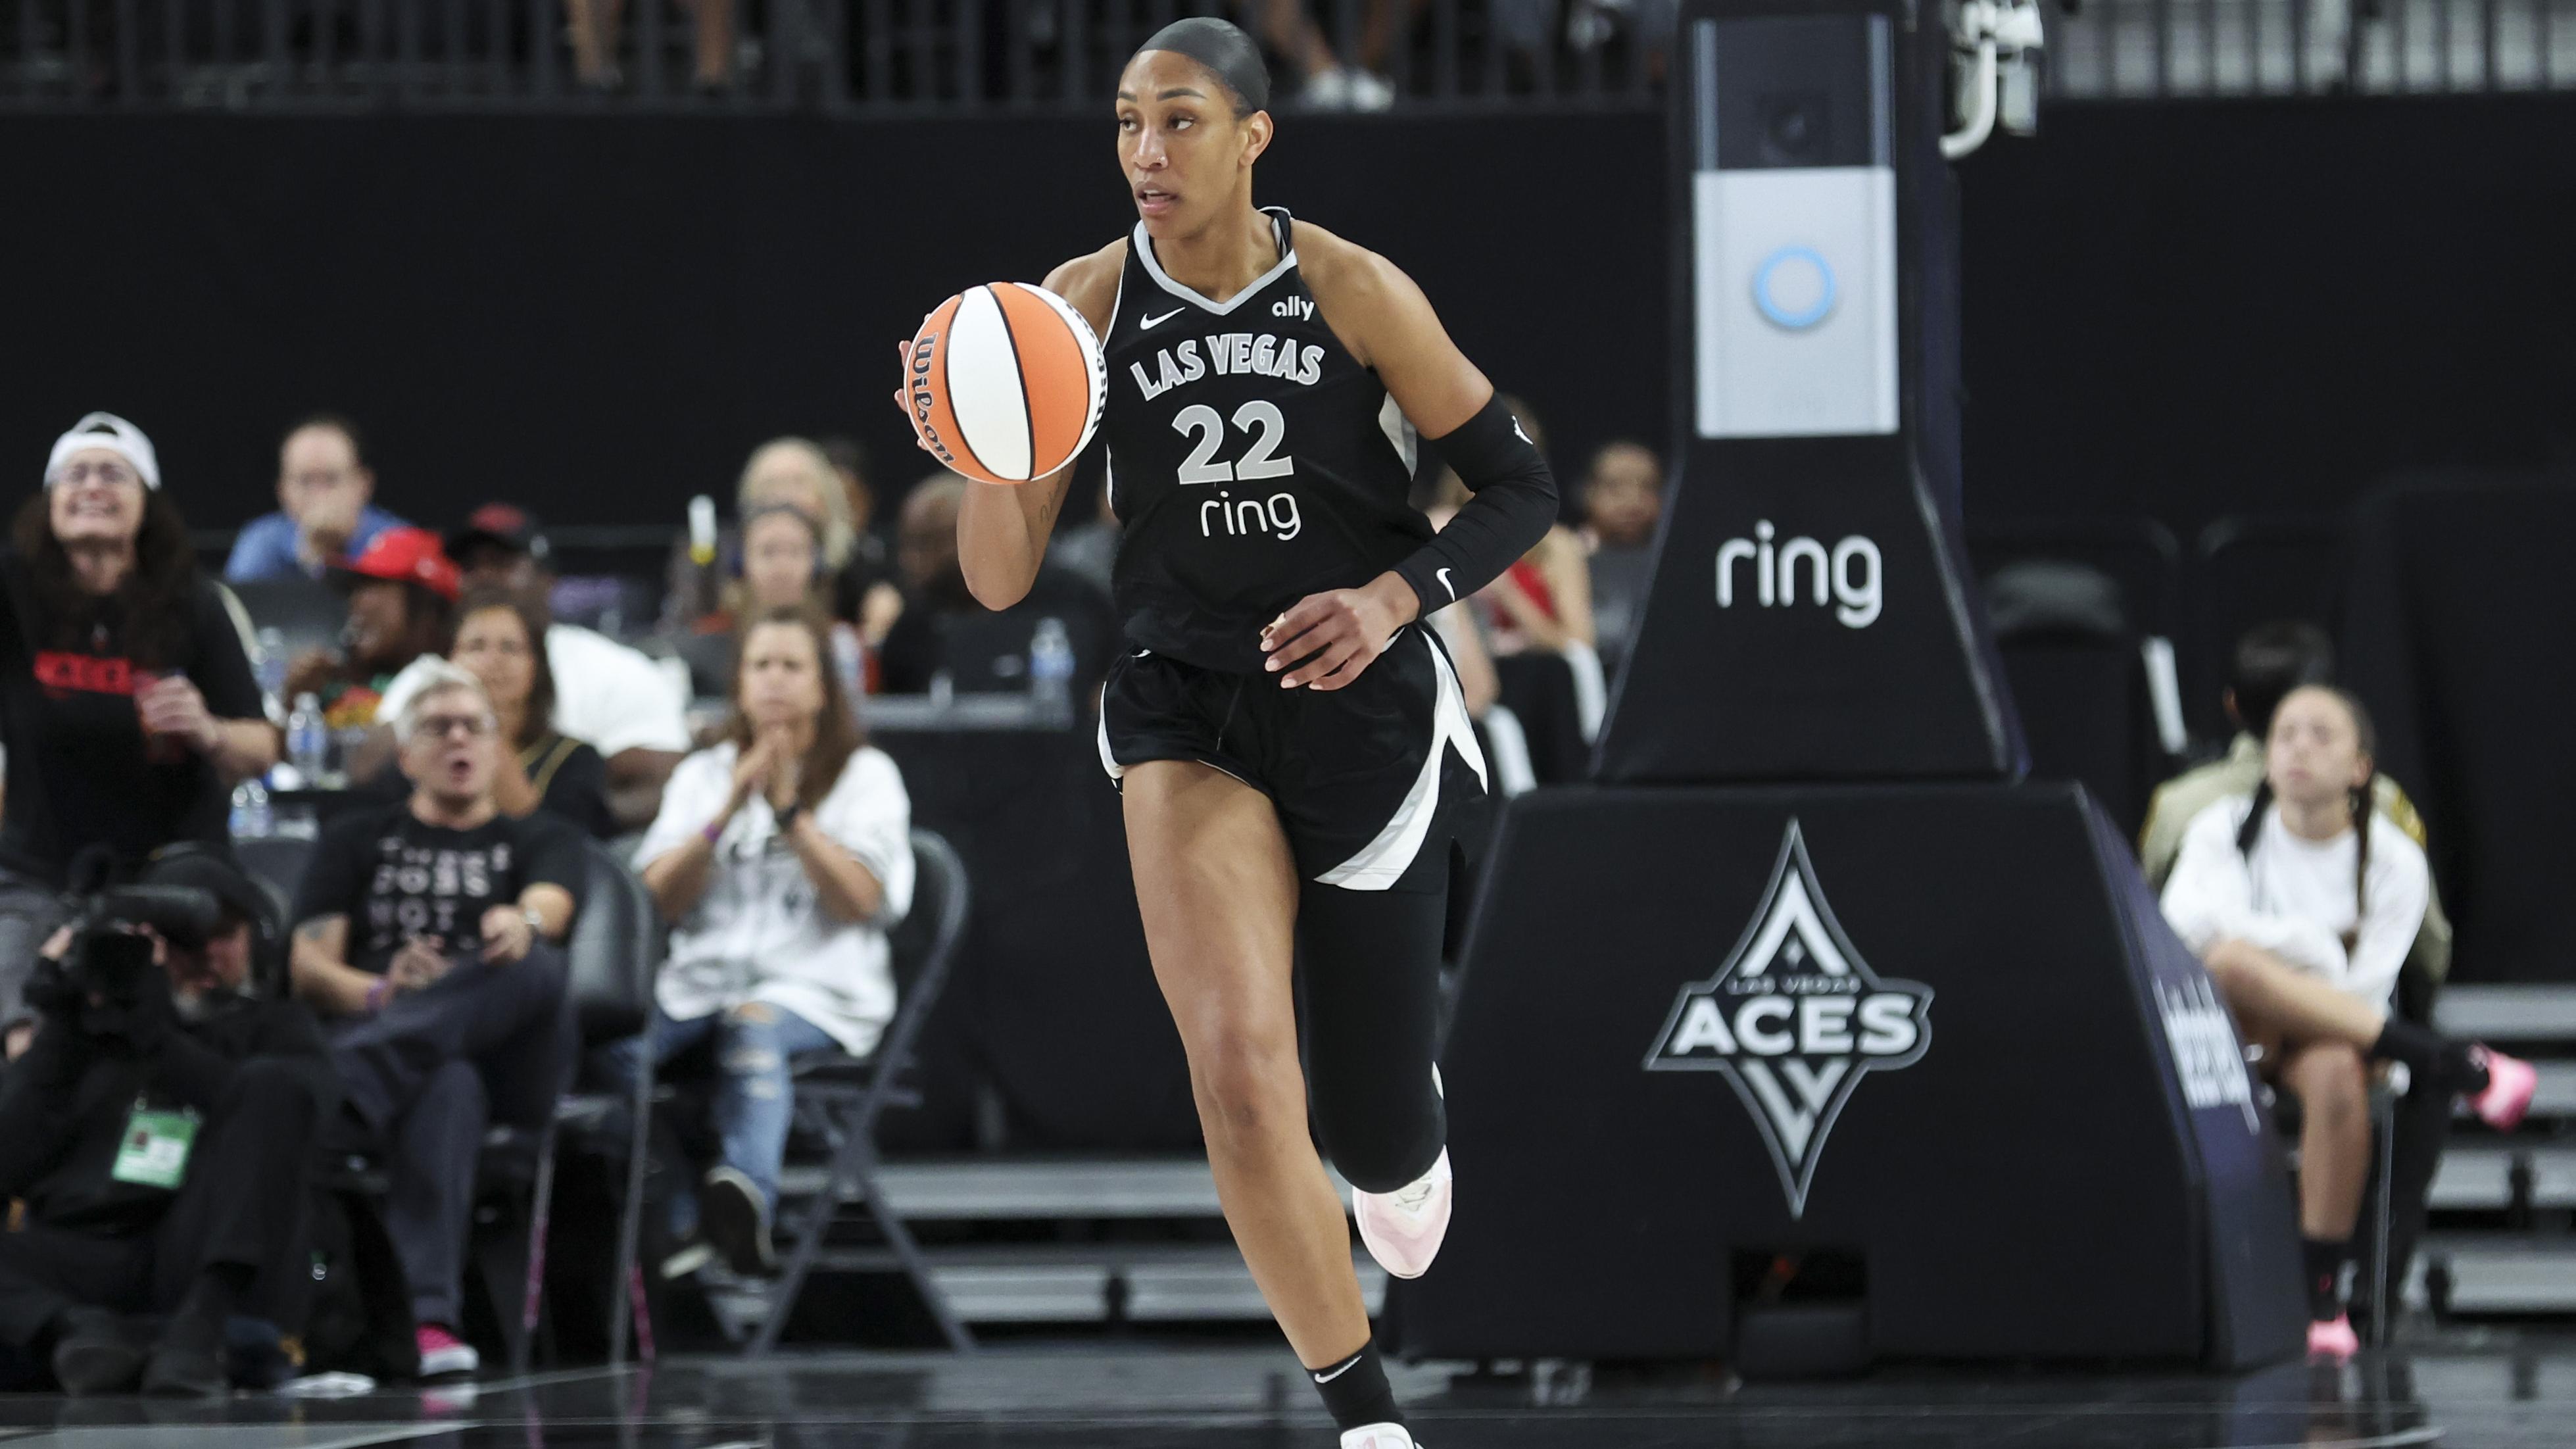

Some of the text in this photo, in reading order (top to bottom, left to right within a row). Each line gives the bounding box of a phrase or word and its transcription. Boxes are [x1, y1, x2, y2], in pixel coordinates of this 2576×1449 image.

[1271, 295, 1315, 321] ally
[911, 332, 956, 463] Wilson
[1130, 333, 1325, 402] LAS VEGAS
[1171, 400, 1294, 485] 22
[1200, 490, 1301, 541] ring
[1715, 518, 1883, 629] ring
[1668, 993, 1918, 1057] ACES
